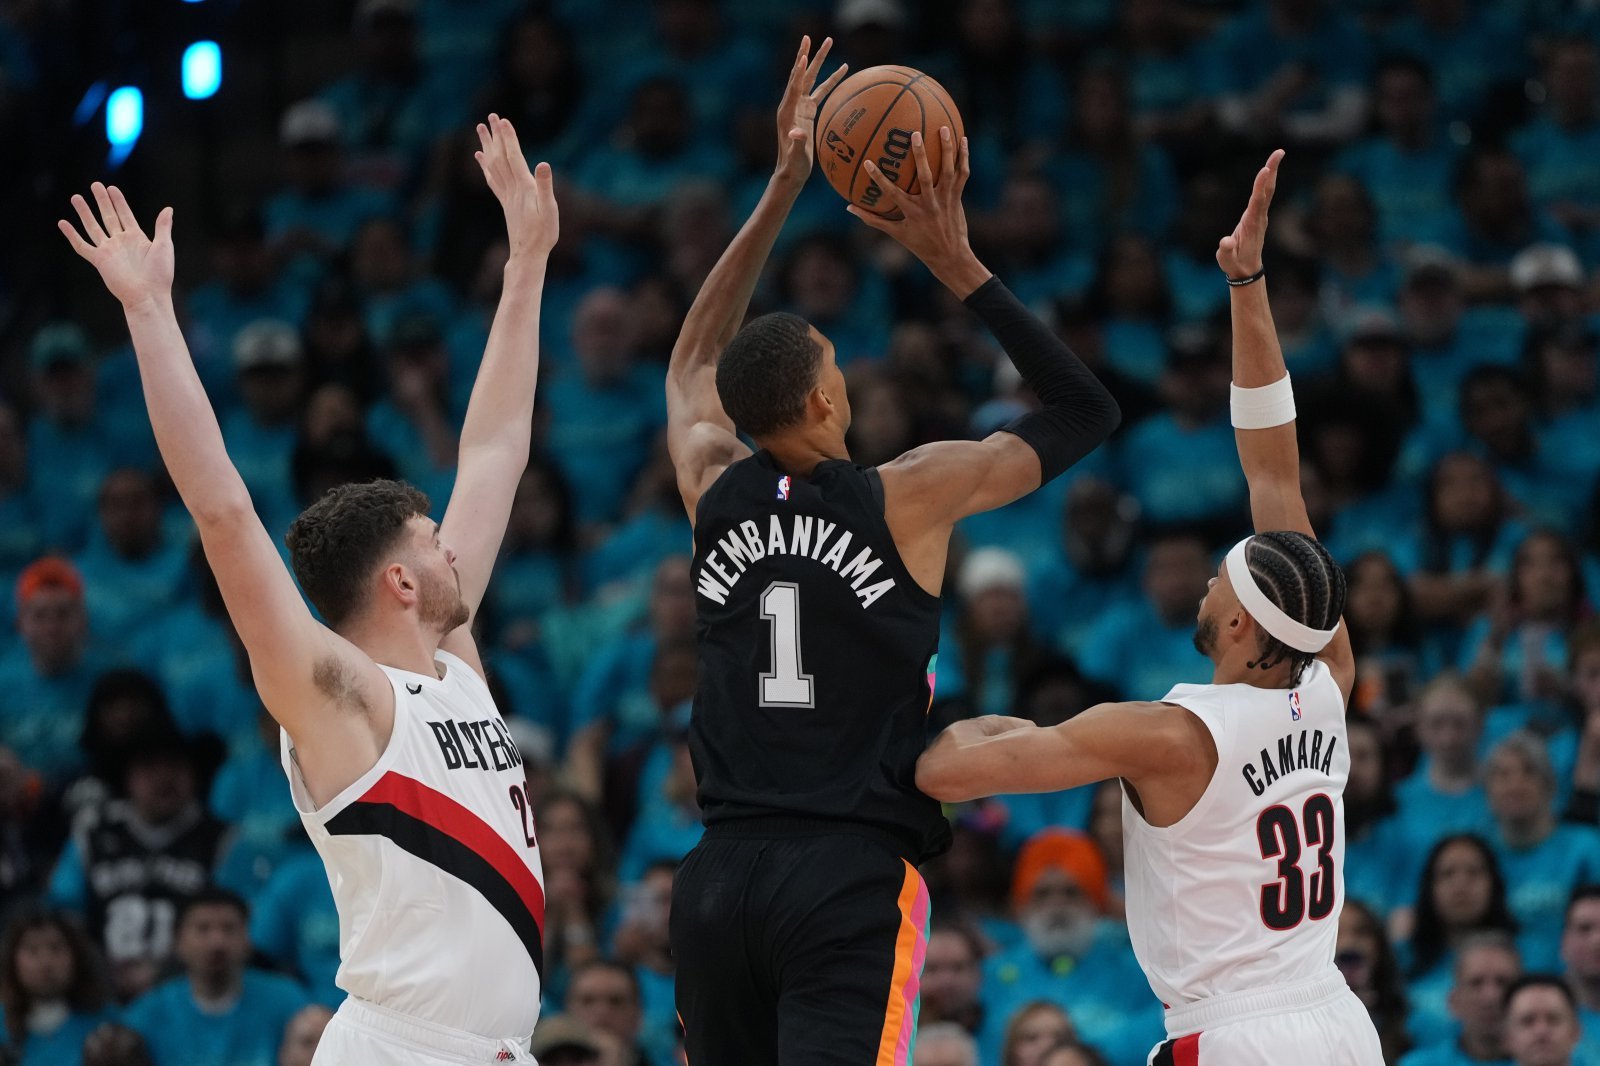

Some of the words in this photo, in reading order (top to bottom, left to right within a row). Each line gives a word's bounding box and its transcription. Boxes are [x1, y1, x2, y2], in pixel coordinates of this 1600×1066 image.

[861, 128, 913, 206] Wilon
[697, 514, 896, 609] WEMBANYAMA
[759, 580, 815, 709] 1
[1242, 729, 1337, 796] CAMARA
[1256, 793, 1335, 931] 33
